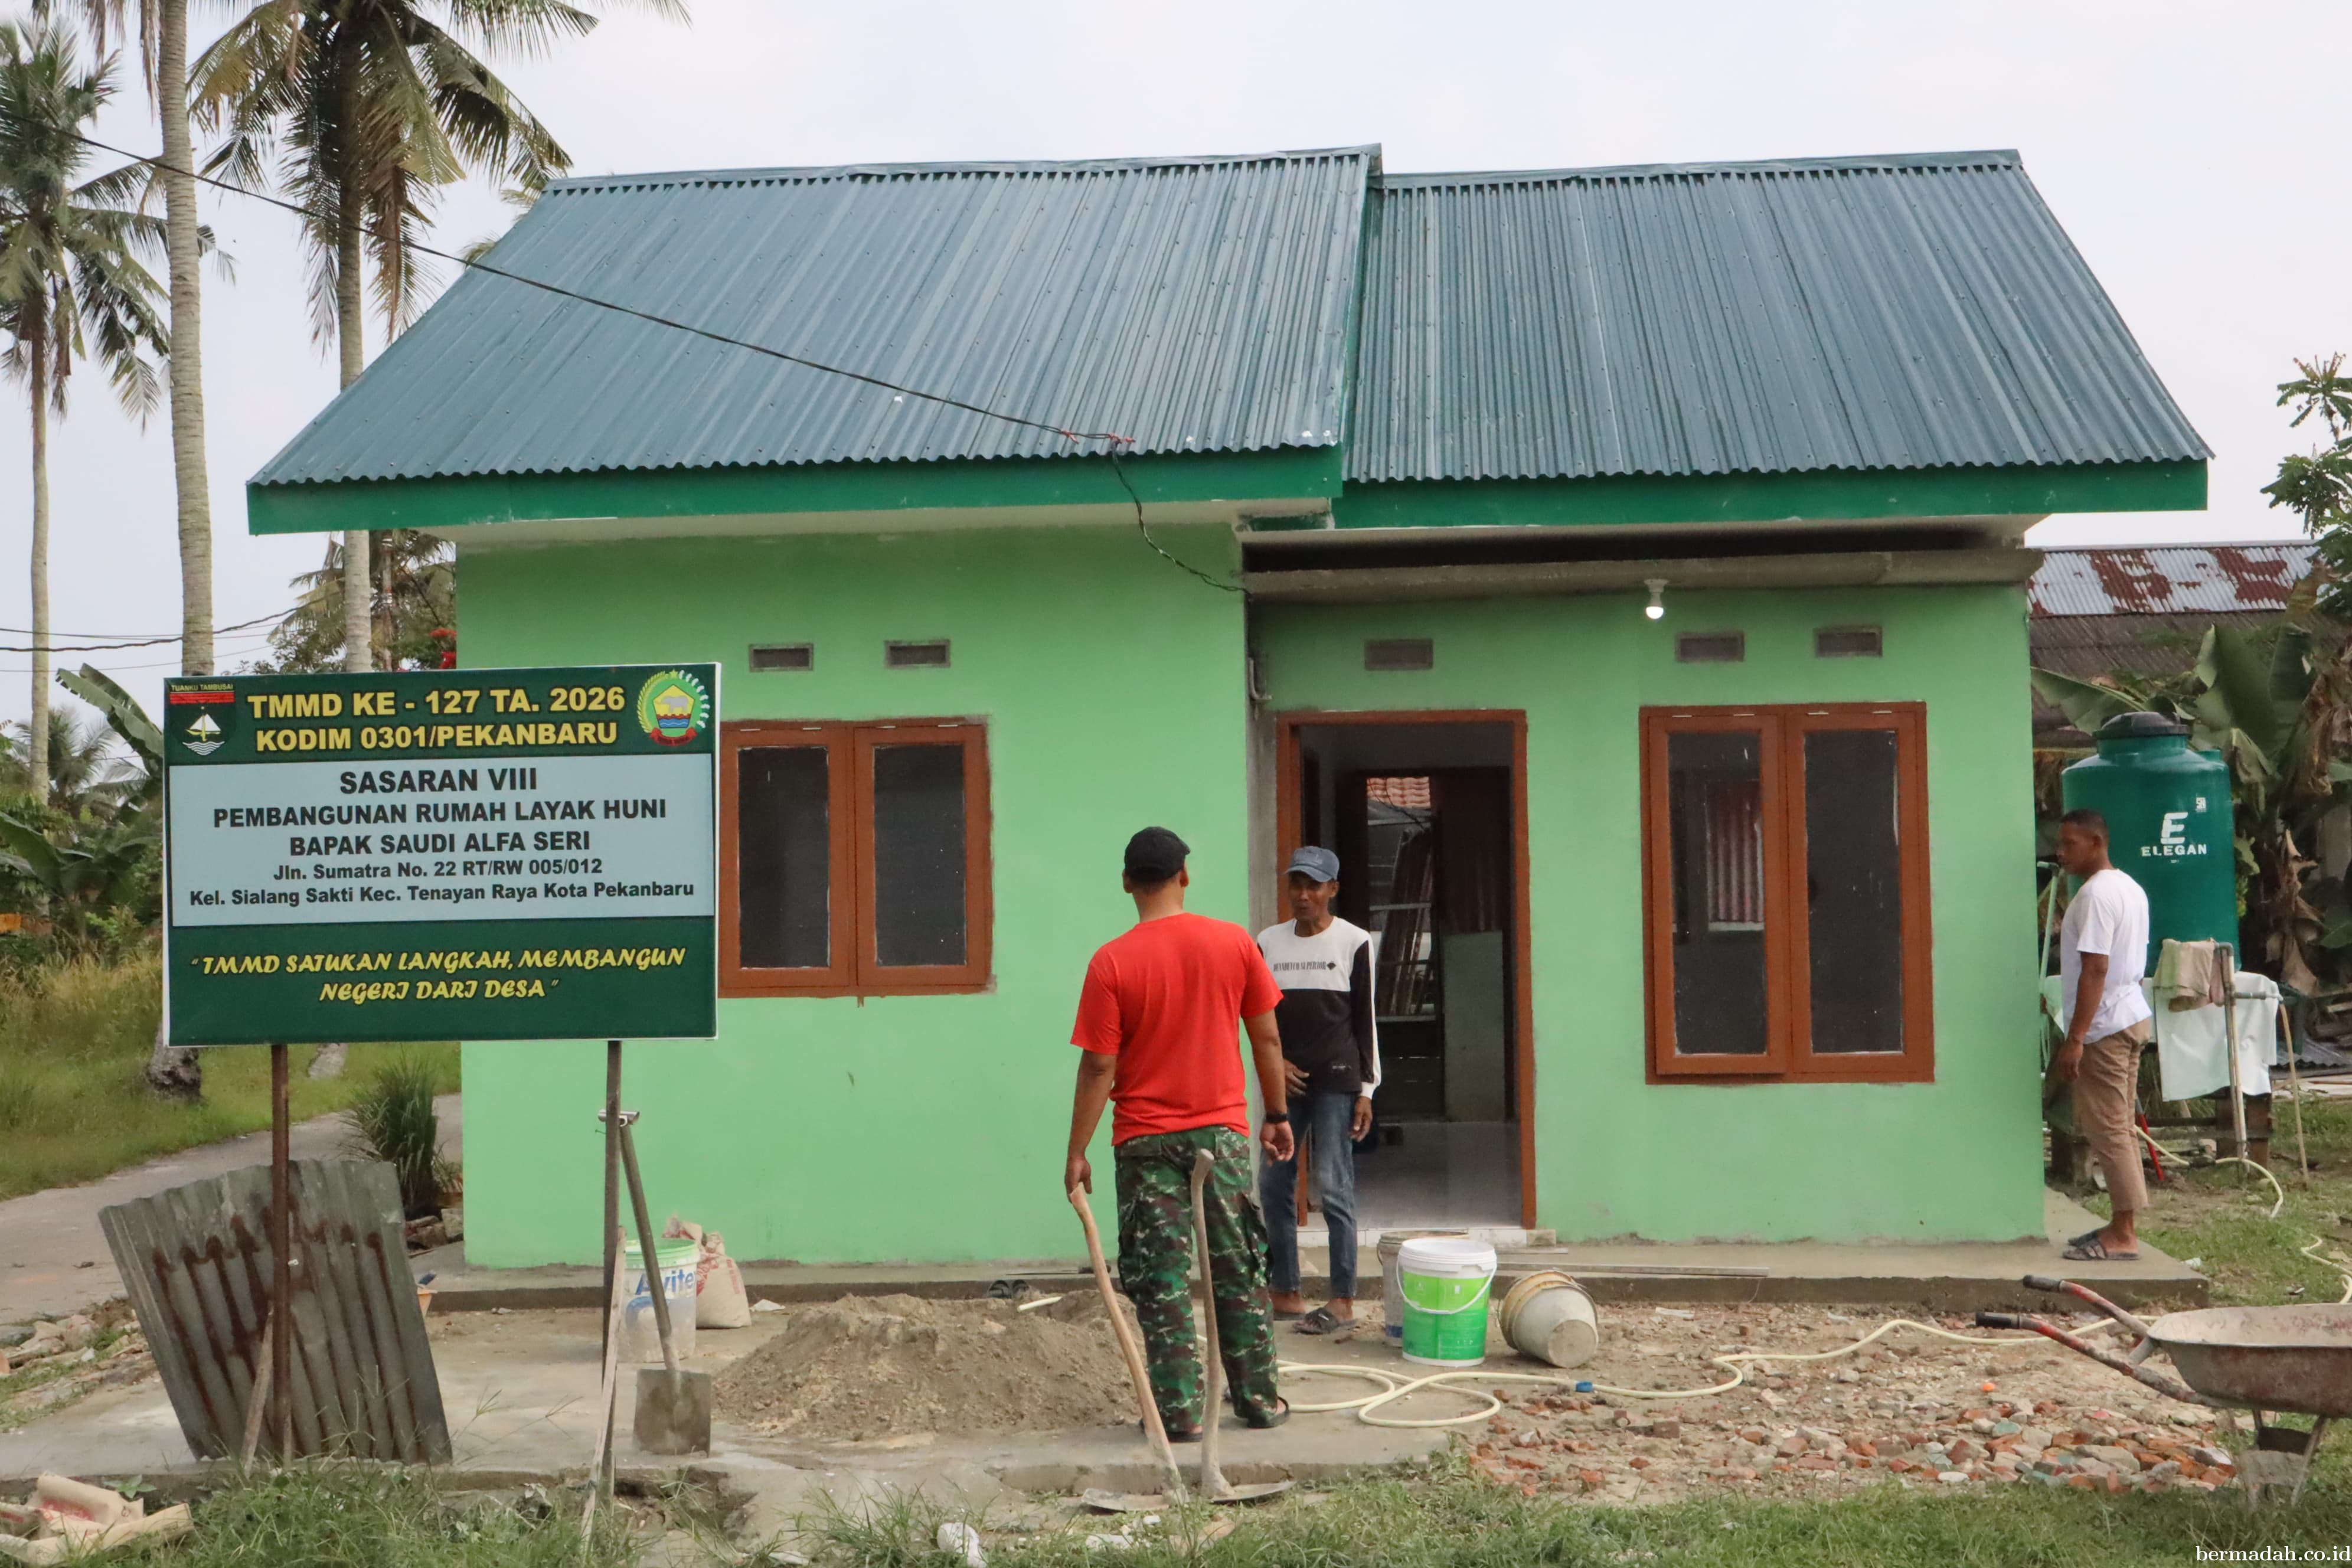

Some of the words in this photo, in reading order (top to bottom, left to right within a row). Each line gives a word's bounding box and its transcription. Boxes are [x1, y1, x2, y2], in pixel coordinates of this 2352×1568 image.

[247, 693, 342, 718] TMMD
[353, 691, 396, 716] KE
[425, 690, 481, 714] 127
[489, 688, 540, 713] TA.
[550, 687, 626, 711] 2026
[256, 728, 351, 752] KODIM
[360, 722, 617, 750] 0301/PEKANBARU
[339, 768, 478, 794] SASARAN
[488, 767, 537, 791] VIII
[214, 803, 407, 828] PEMBANGUNAN
[416, 802, 506, 823] RUMAH
[515, 800, 596, 821] LAYAK
[603, 799, 667, 819] HUNI
[2160, 812, 2188, 845] E
[290, 835, 373, 856] BAPAK
[380, 834, 455, 854] SAUDI
[463, 832, 526, 852] ALFA
[533, 831, 590, 851] SERI
[2140, 844, 2207, 857] ELEGAN
[273, 865, 307, 881] Jln.
[313, 863, 391, 880] Sumatra
[397, 863, 427, 877] No.
[433, 861, 456, 877] 22
[463, 860, 524, 876] RT/RW
[529, 858, 603, 875] 005/012
[190, 890, 226, 906] Kel.
[231, 889, 300, 907] Sialang
[306, 887, 354, 903] Sakti
[360, 886, 401, 902] Kec.
[407, 886, 485, 904] Tenayan
[492, 884, 538, 903] Raya
[544, 883, 588, 899] Kota
[594, 881, 694, 897] Pekanbaru
[285, 952, 393, 973] SATUKAN
[398, 950, 513, 974] LANGKAH,
[517, 948, 686, 971] MEMBANGUN
[319, 981, 410, 1005] NEGERI
[415, 979, 479, 999] DARI
